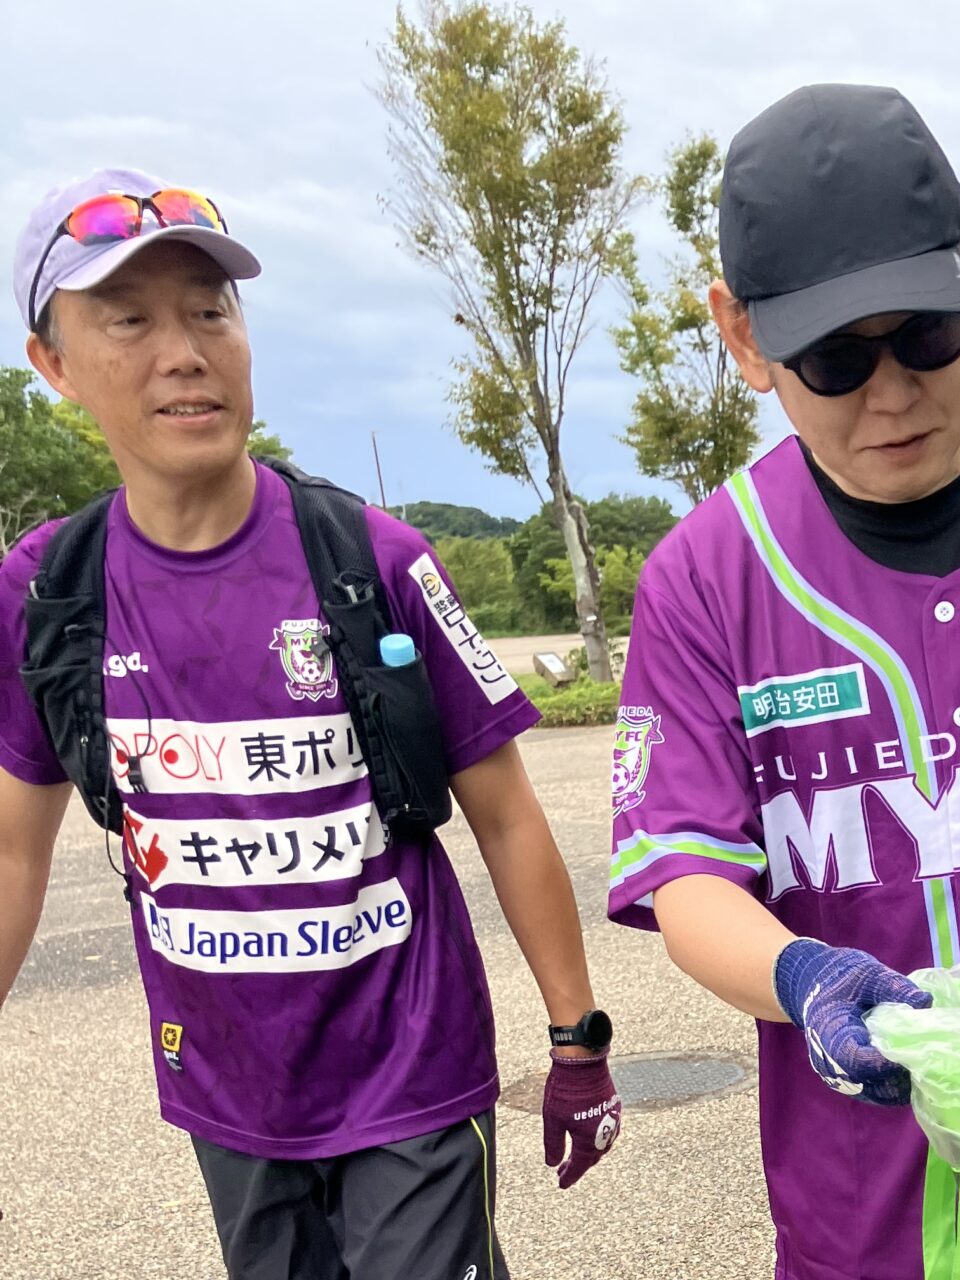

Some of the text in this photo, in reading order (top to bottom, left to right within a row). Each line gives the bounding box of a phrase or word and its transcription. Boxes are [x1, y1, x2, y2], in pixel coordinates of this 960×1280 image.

[752, 681, 840, 720] 明治安田
[179, 922, 289, 964] Japan
[295, 899, 407, 957] Sleeve
